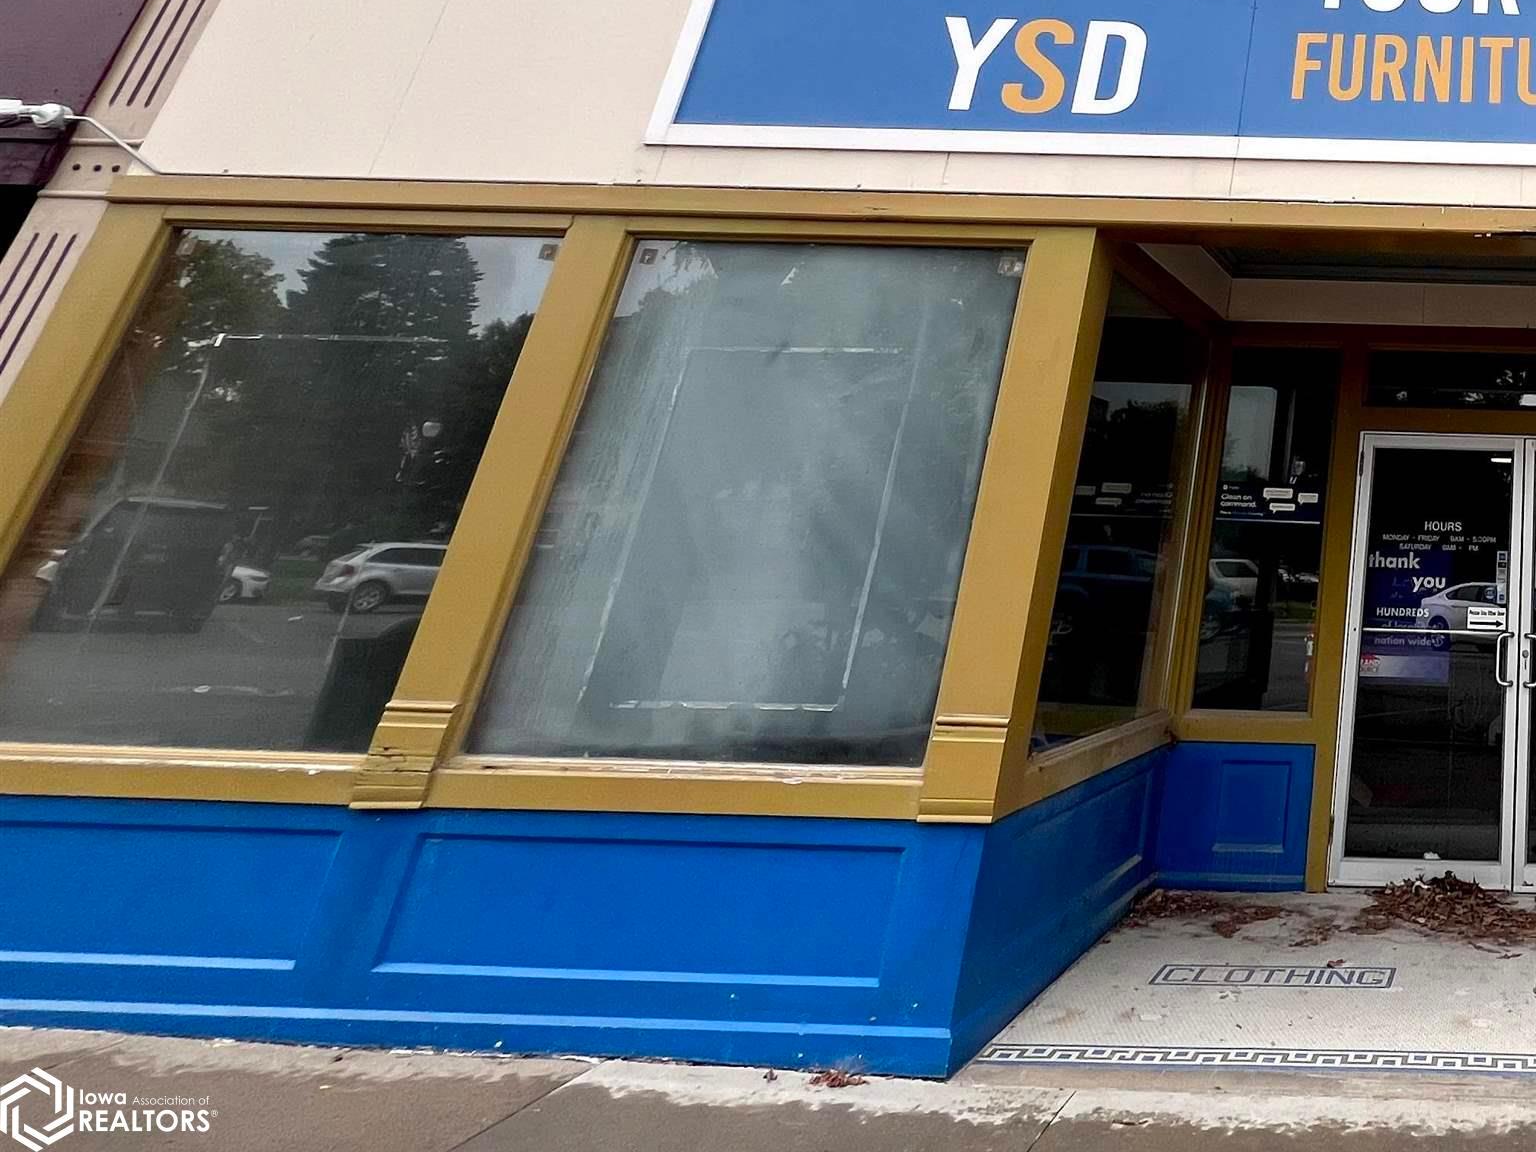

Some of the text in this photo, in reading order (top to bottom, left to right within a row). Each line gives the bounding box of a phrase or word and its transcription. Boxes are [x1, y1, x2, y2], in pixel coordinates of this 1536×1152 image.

[945, 16, 1148, 114] YSD
[1424, 521, 1462, 532] HOURS
[1368, 551, 1420, 568] thank
[1412, 576, 1446, 592] you
[1376, 607, 1430, 617] HUNDREDS
[1374, 635, 1405, 645] nation
[1162, 967, 1387, 985] CLOTHING
